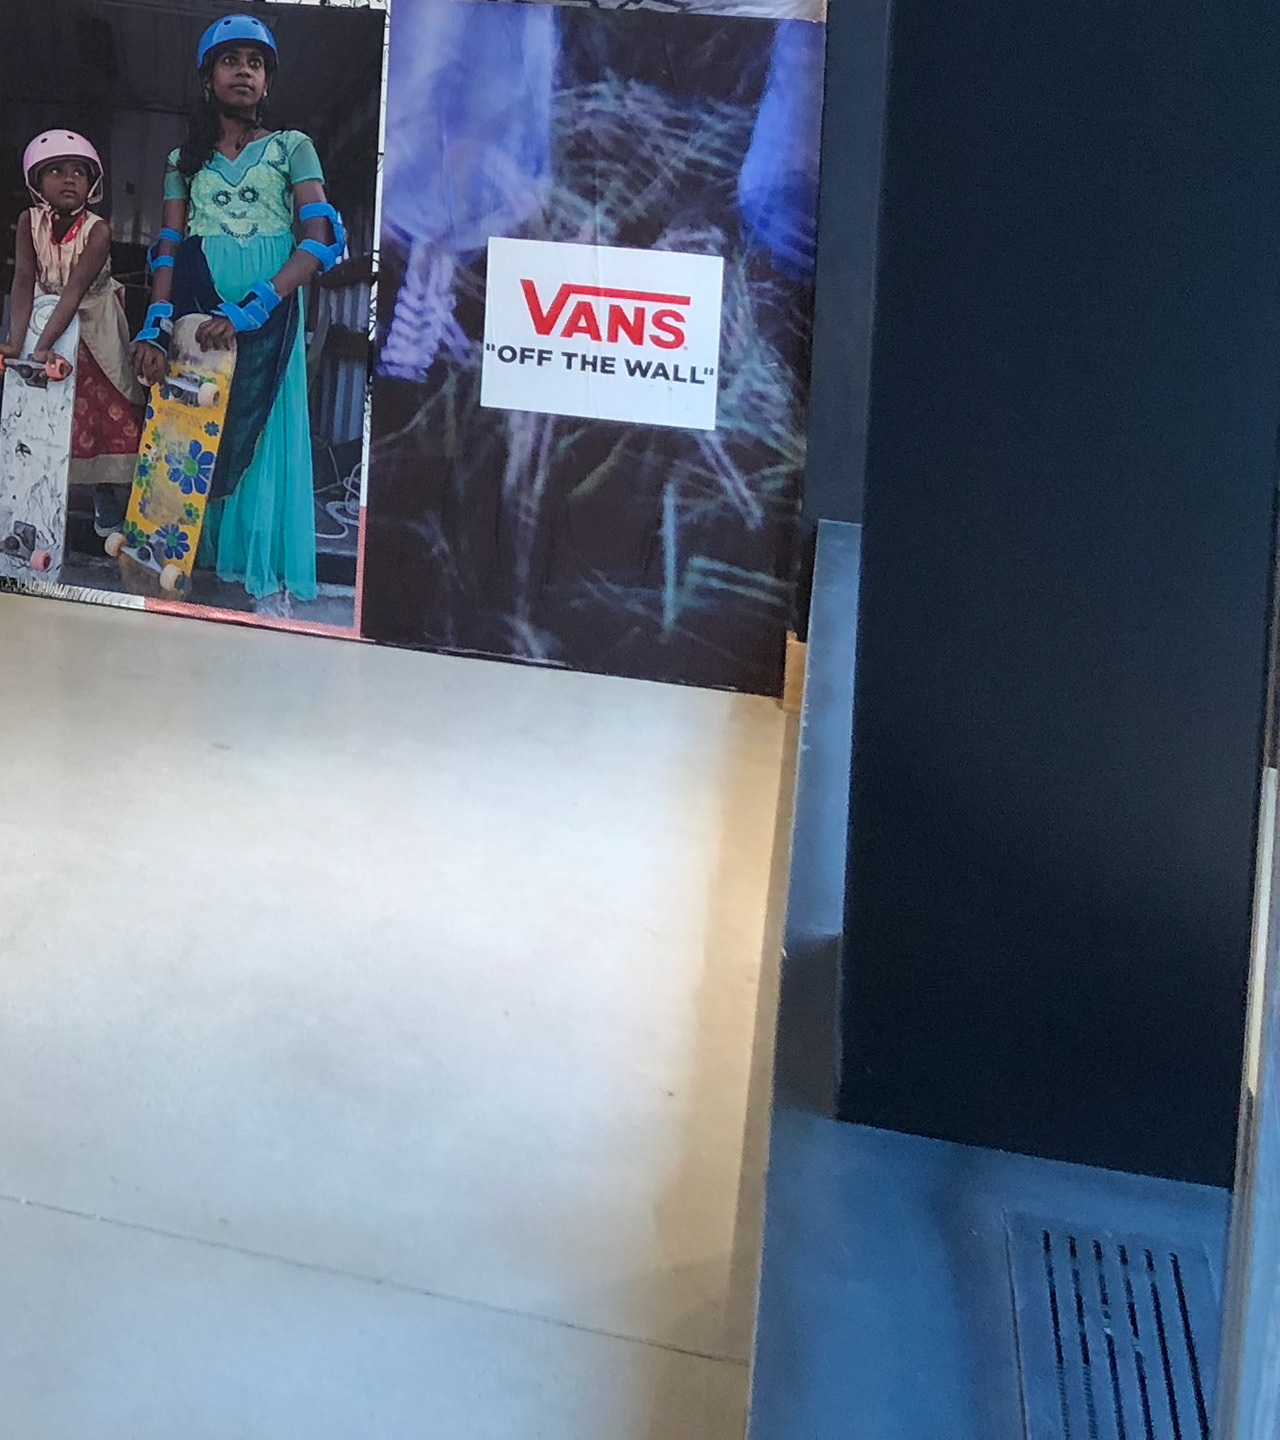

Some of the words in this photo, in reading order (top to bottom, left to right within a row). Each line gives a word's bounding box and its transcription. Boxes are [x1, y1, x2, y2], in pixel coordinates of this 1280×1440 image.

[521, 278, 690, 350] VANS
[486, 343, 553, 366] "OFF
[561, 351, 616, 374] THE
[624, 359, 714, 384] WALL"
